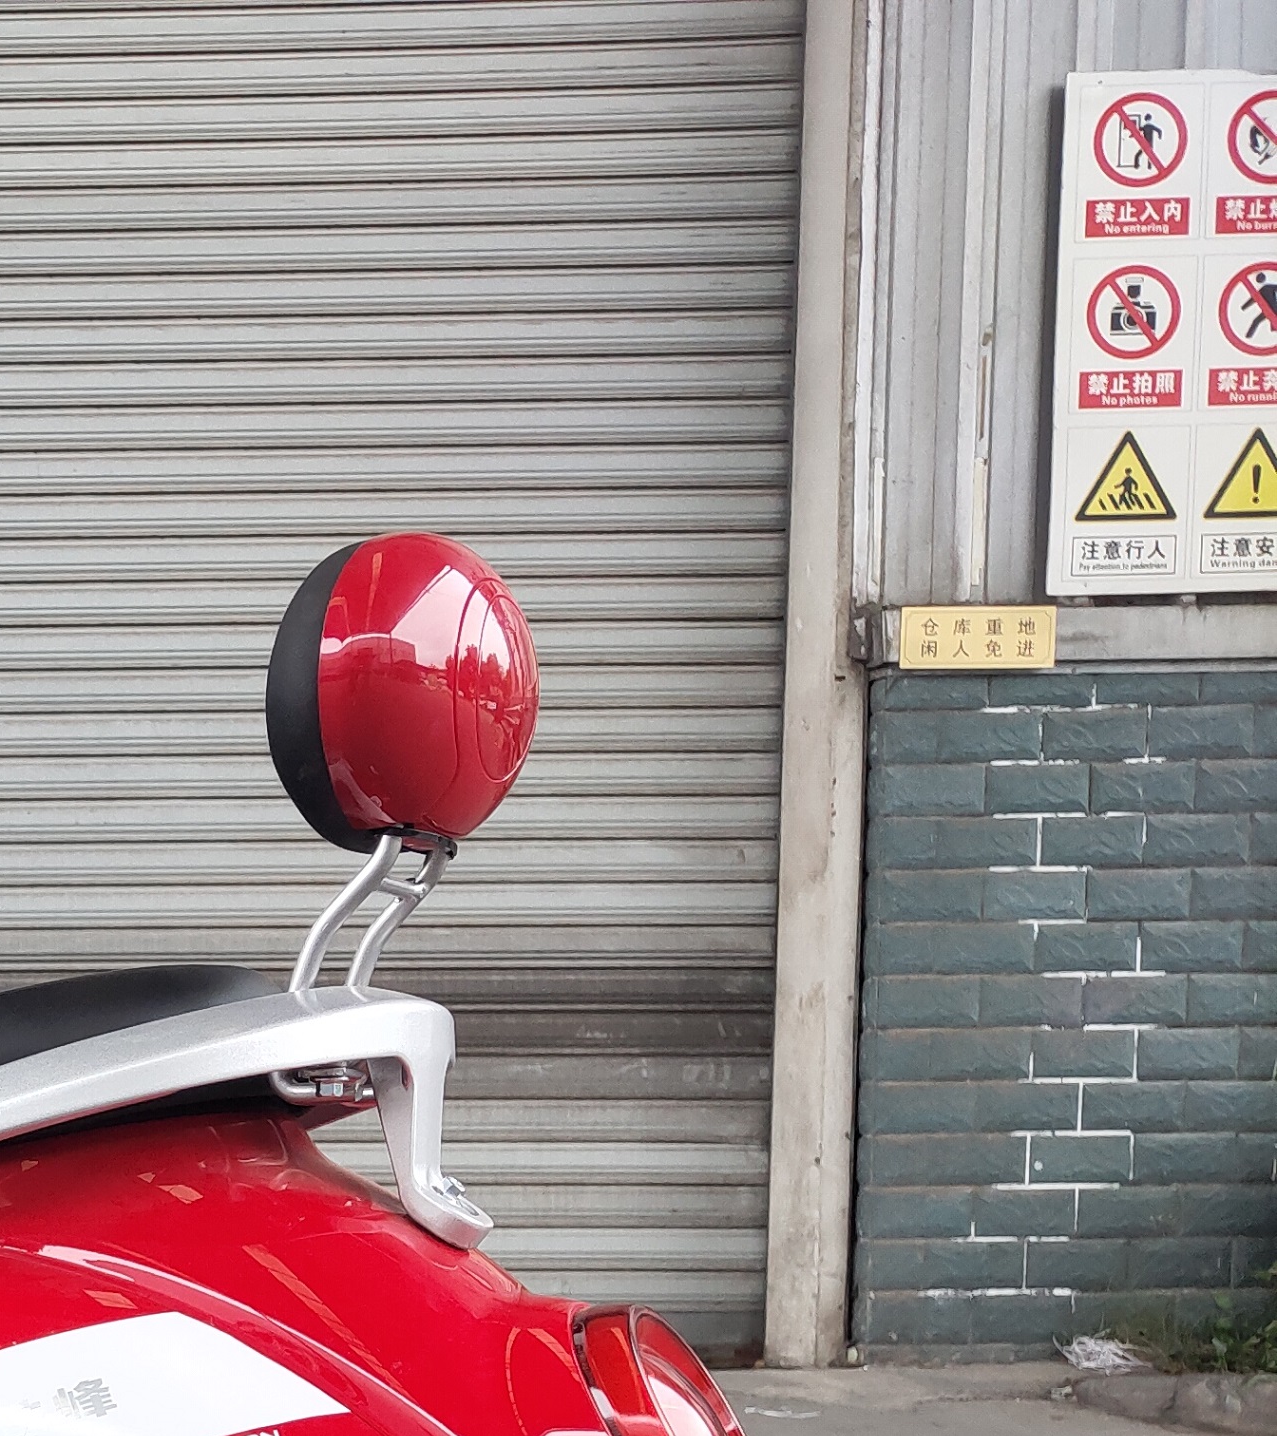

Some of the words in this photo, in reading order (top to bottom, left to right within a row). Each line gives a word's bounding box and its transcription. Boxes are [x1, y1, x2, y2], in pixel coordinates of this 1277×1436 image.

[1095, 200, 1181, 224] 禁止入内
[1104, 224, 1120, 234] No
[1123, 222, 1169, 234] entering
[1088, 372, 1175, 395] 禁止拍照
[1102, 395, 1117, 405] No
[1230, 392, 1245, 403] No
[1081, 540, 1166, 560] 注意行人
[921, 617, 1036, 637] 仓库重地
[921, 639, 1035, 658] 闲人免进
